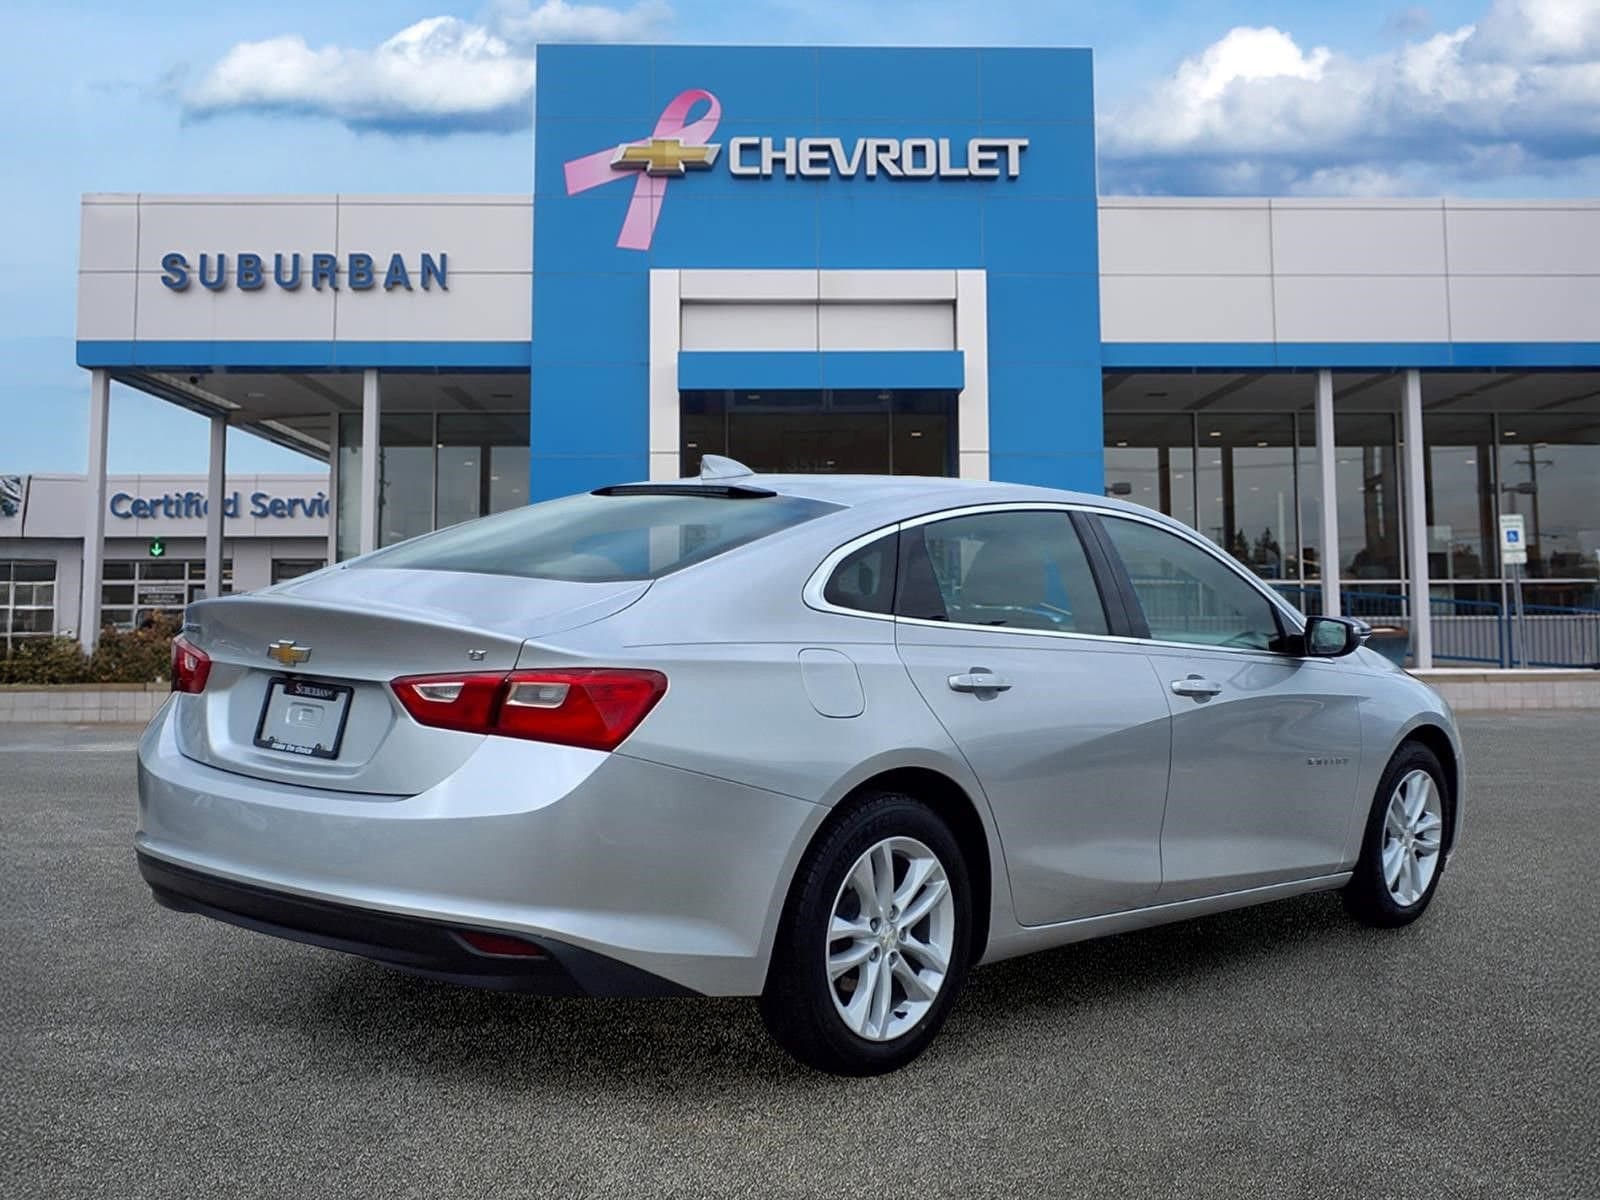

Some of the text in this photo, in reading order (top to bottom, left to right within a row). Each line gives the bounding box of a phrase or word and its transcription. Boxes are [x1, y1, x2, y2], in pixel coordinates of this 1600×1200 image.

[729, 136, 1030, 178] CHEVROLET
[160, 251, 449, 292] SUBURBAN
[109, 491, 241, 519] Certifid
